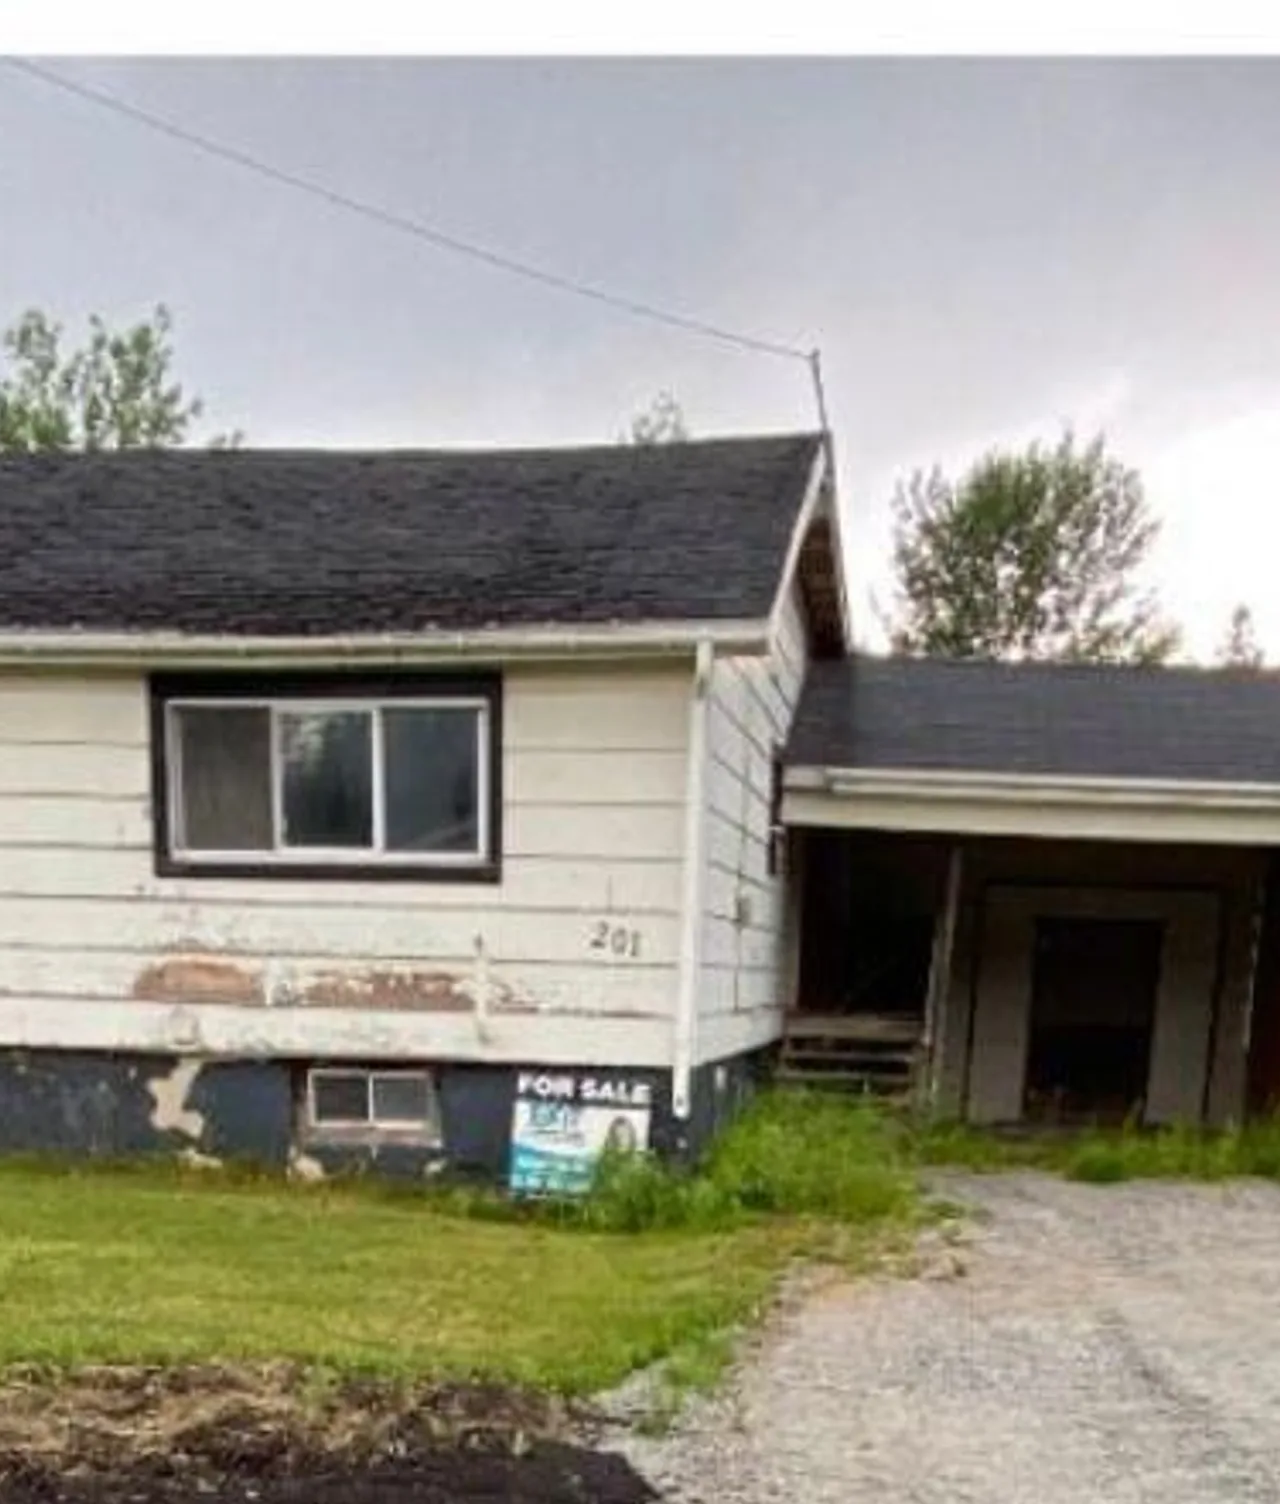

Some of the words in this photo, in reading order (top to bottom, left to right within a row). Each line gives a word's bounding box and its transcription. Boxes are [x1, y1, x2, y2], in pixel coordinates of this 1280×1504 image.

[590, 920, 641, 957] 201
[518, 1073, 574, 1098] FOR
[580, 1077, 651, 1103] SALE
